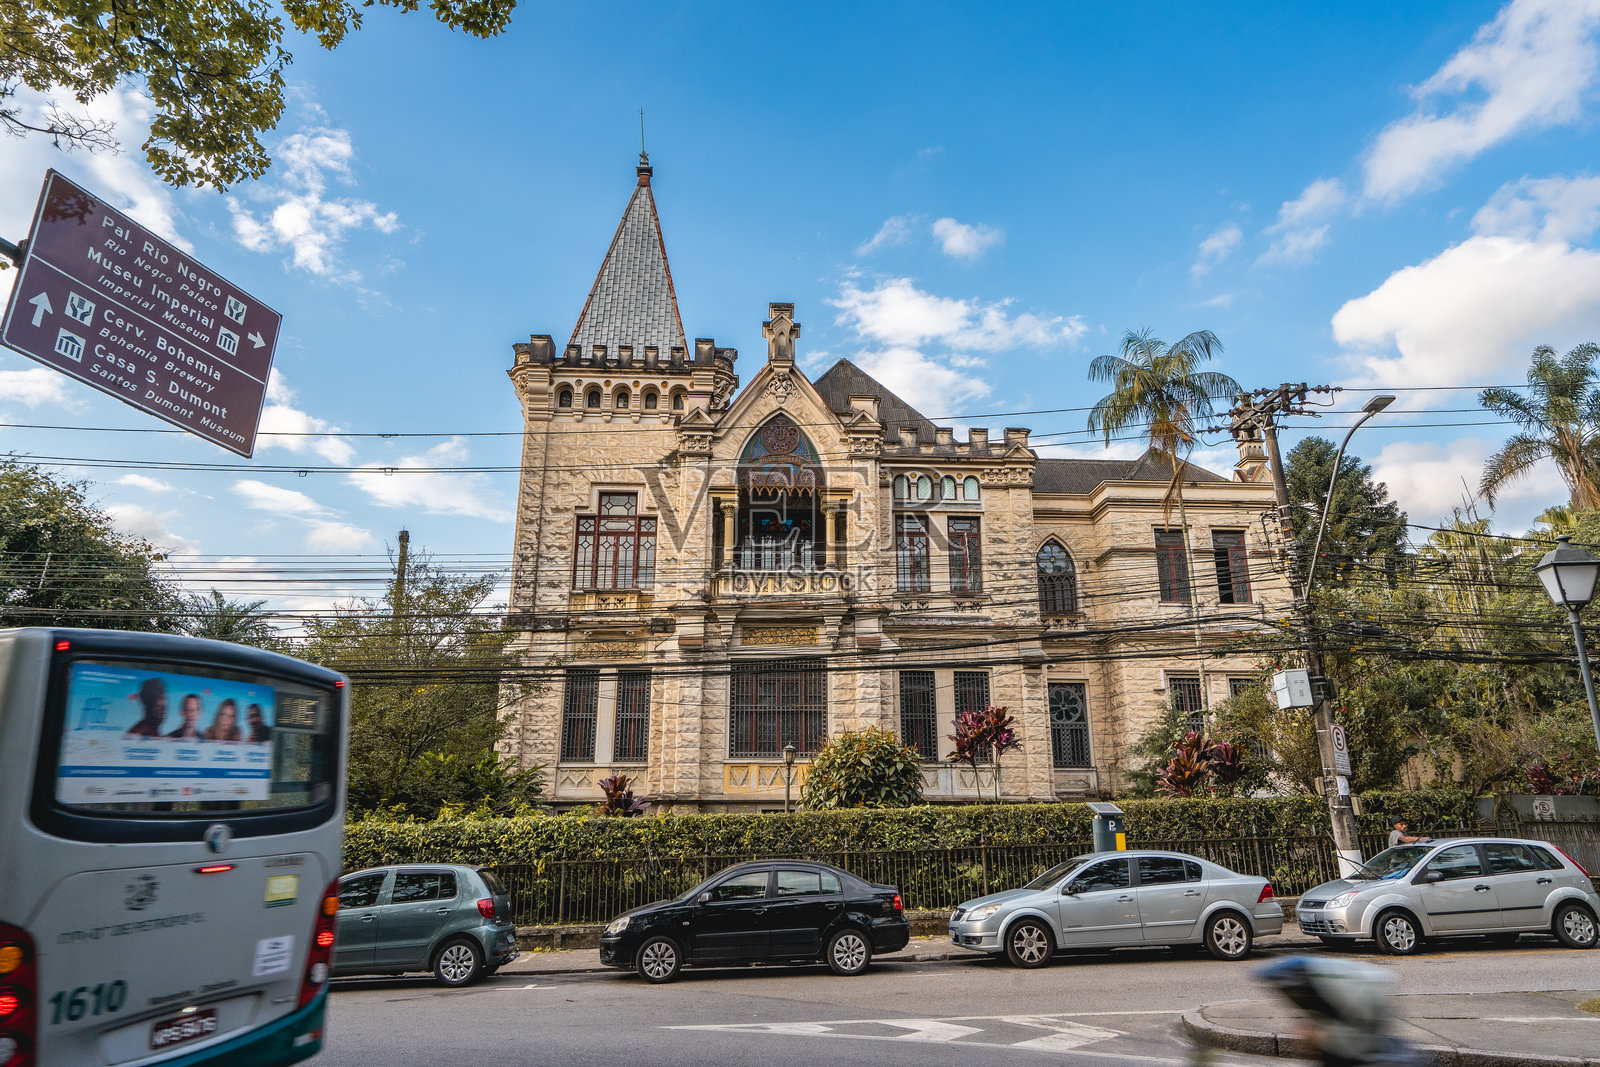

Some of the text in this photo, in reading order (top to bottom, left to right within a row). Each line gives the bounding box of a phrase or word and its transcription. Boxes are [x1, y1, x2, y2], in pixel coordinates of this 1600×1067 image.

[87, 246, 215, 329] Museu Imperial
[102, 215, 222, 297] Pal. Rio Negro
[104, 238, 218, 311] Rio Negro Palace
[98, 275, 210, 343] Imperial Museum
[103, 309, 222, 381] Cerv. Bohemia
[94, 343, 228, 419] Casa S. Dumont
[99, 327, 215, 393] Bohemia Brewery
[90, 363, 246, 443] Santos Dumont Museum
[48, 979, 127, 1025] 1610
